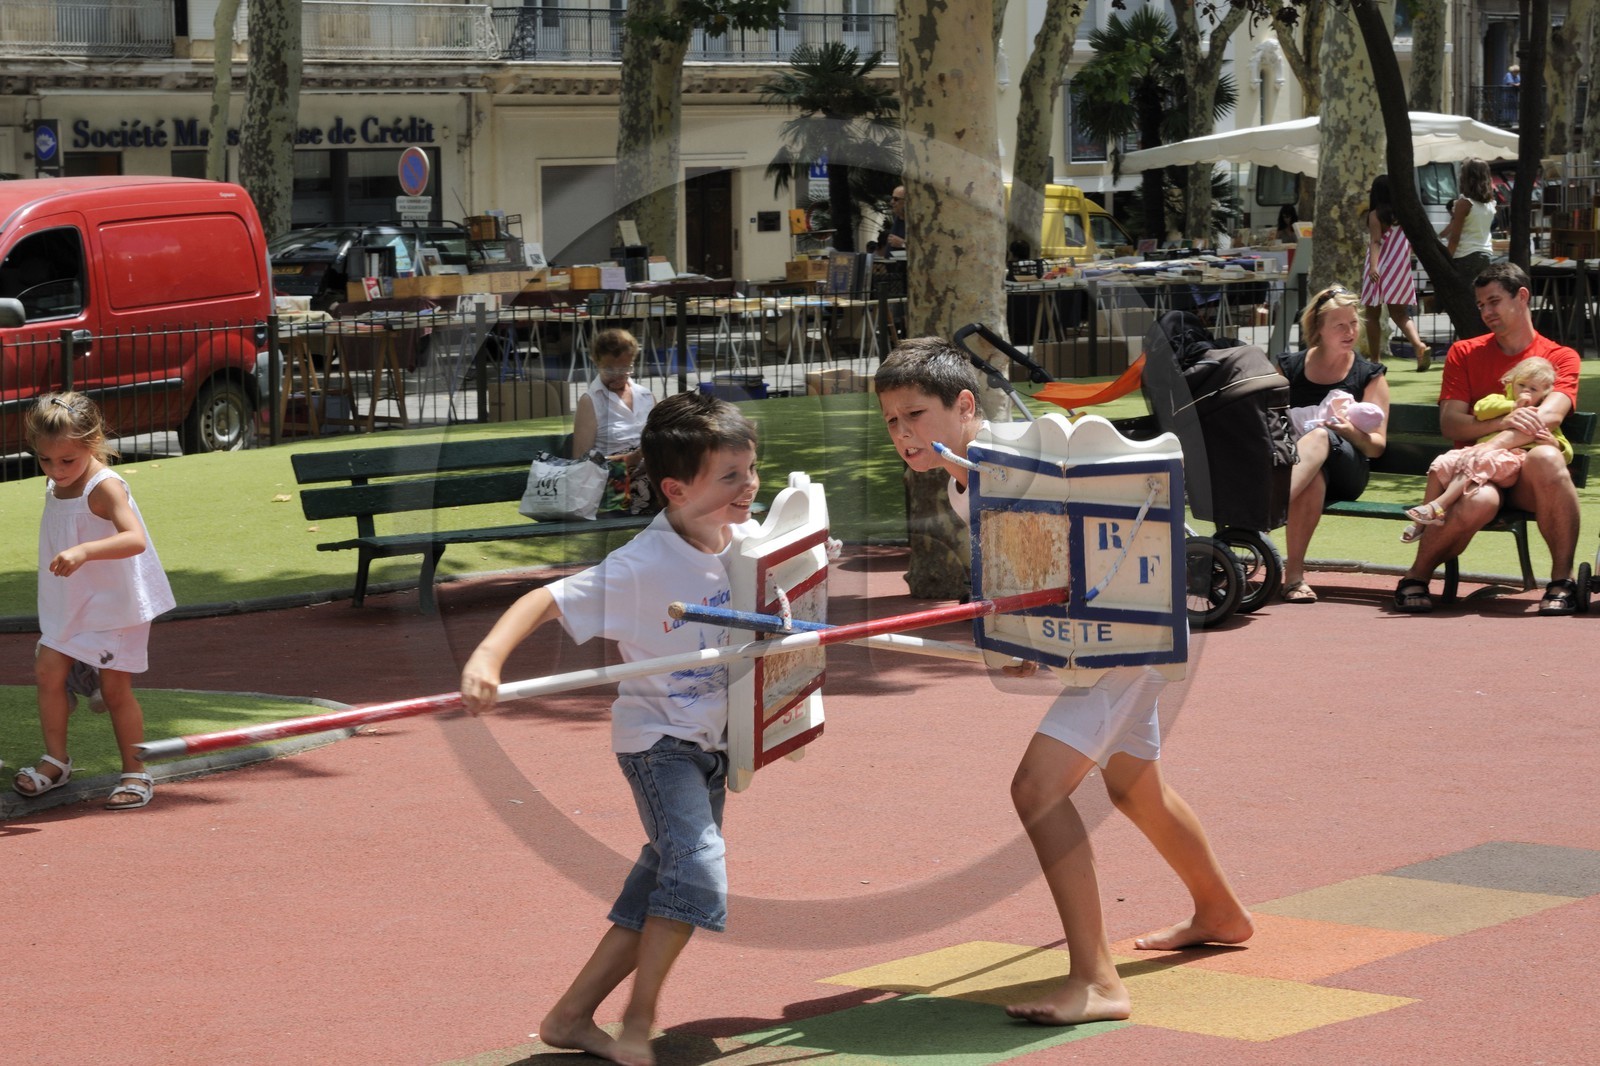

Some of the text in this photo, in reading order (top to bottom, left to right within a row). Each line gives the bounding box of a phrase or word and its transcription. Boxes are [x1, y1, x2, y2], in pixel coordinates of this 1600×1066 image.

[73, 119, 168, 148] Société
[327, 116, 357, 144] de
[361, 116, 435, 144] Crédit
[1097, 522, 1123, 550] R
[1138, 555, 1160, 584] F
[1042, 619, 1113, 643] SETE
